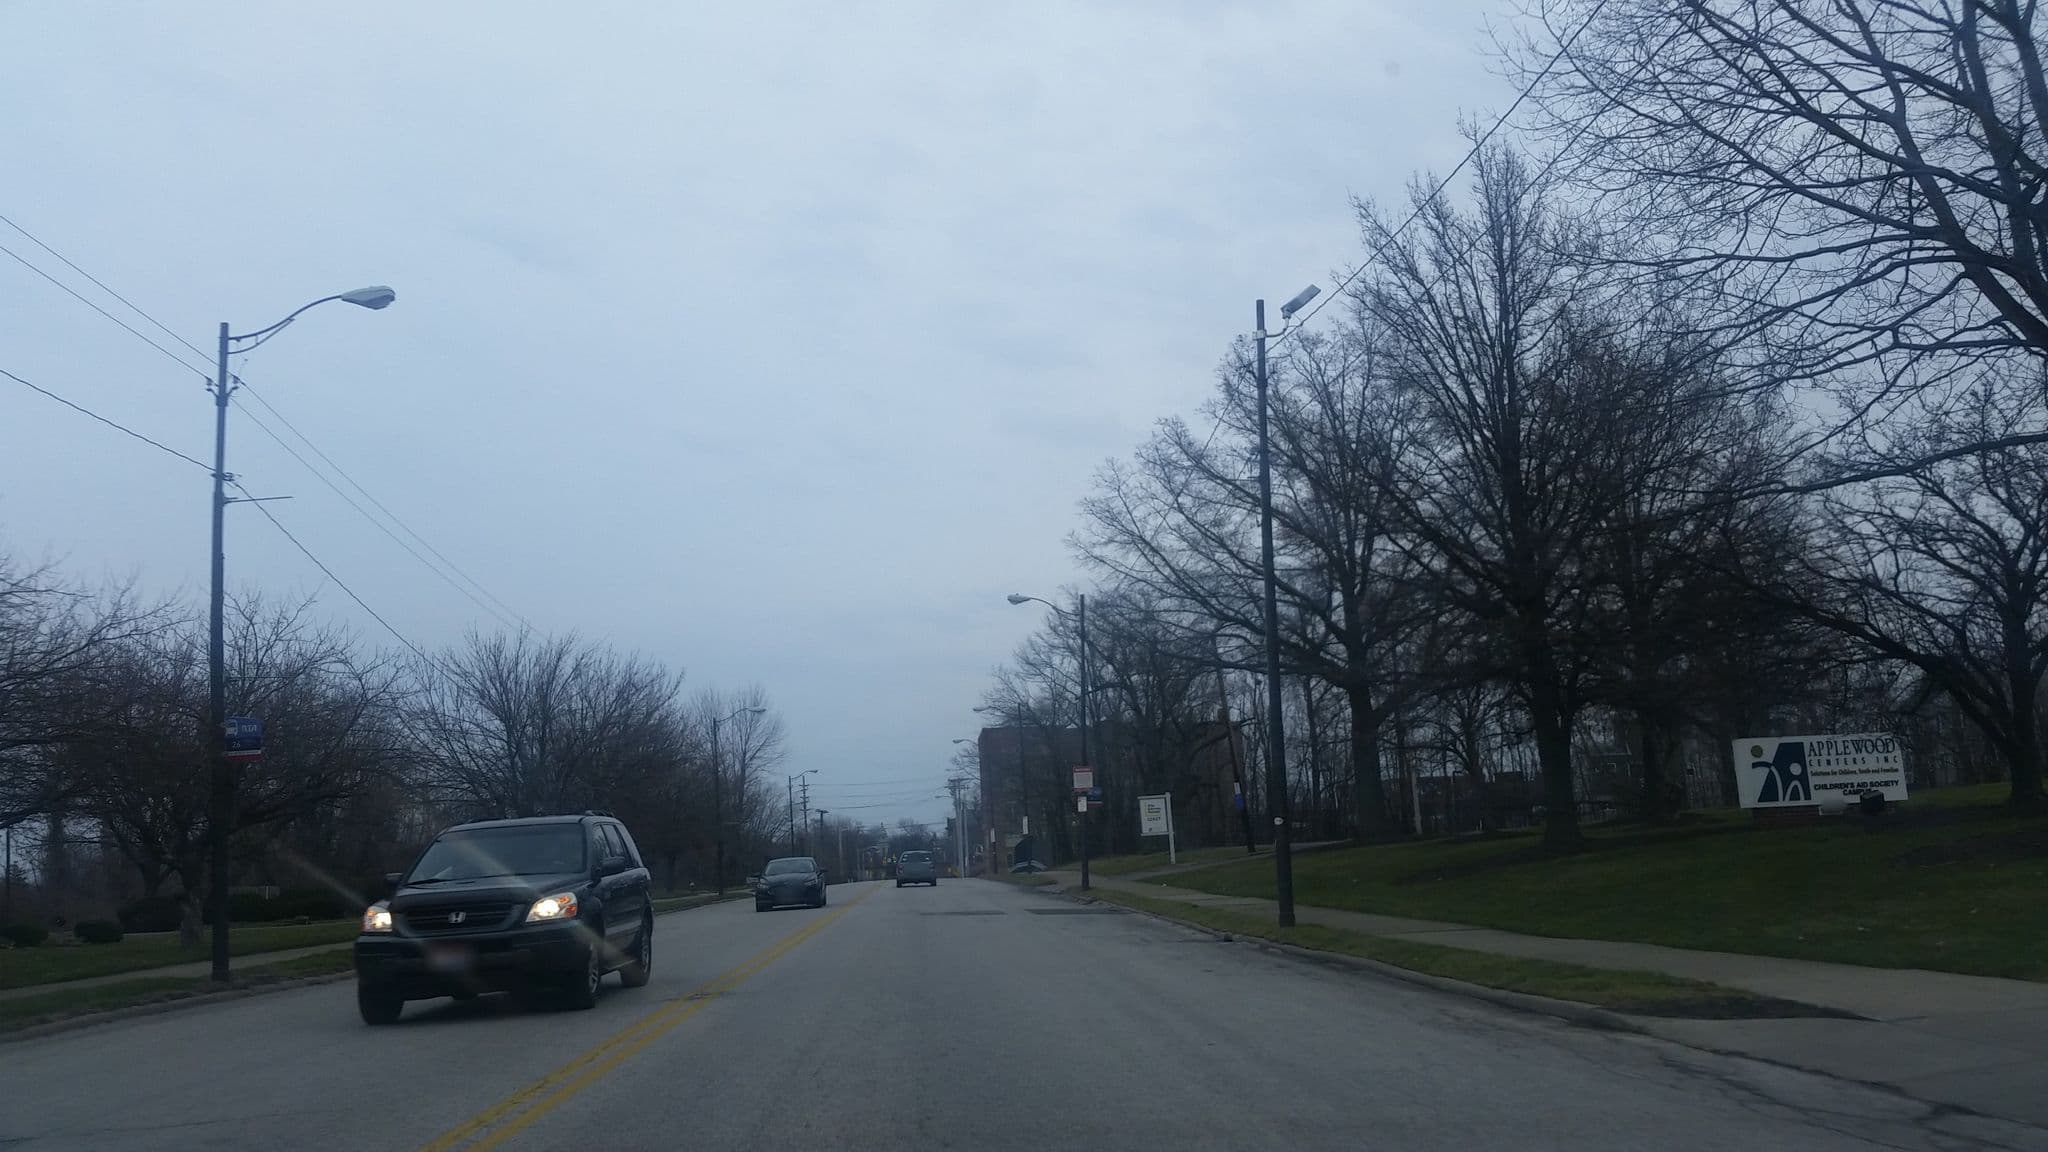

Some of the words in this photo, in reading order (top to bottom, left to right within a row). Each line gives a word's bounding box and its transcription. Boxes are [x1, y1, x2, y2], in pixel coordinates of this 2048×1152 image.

[1809, 738, 1895, 757] APPLEWOOD
[1809, 757, 1866, 767] CENTERS
[1876, 755, 1898, 763] INC
